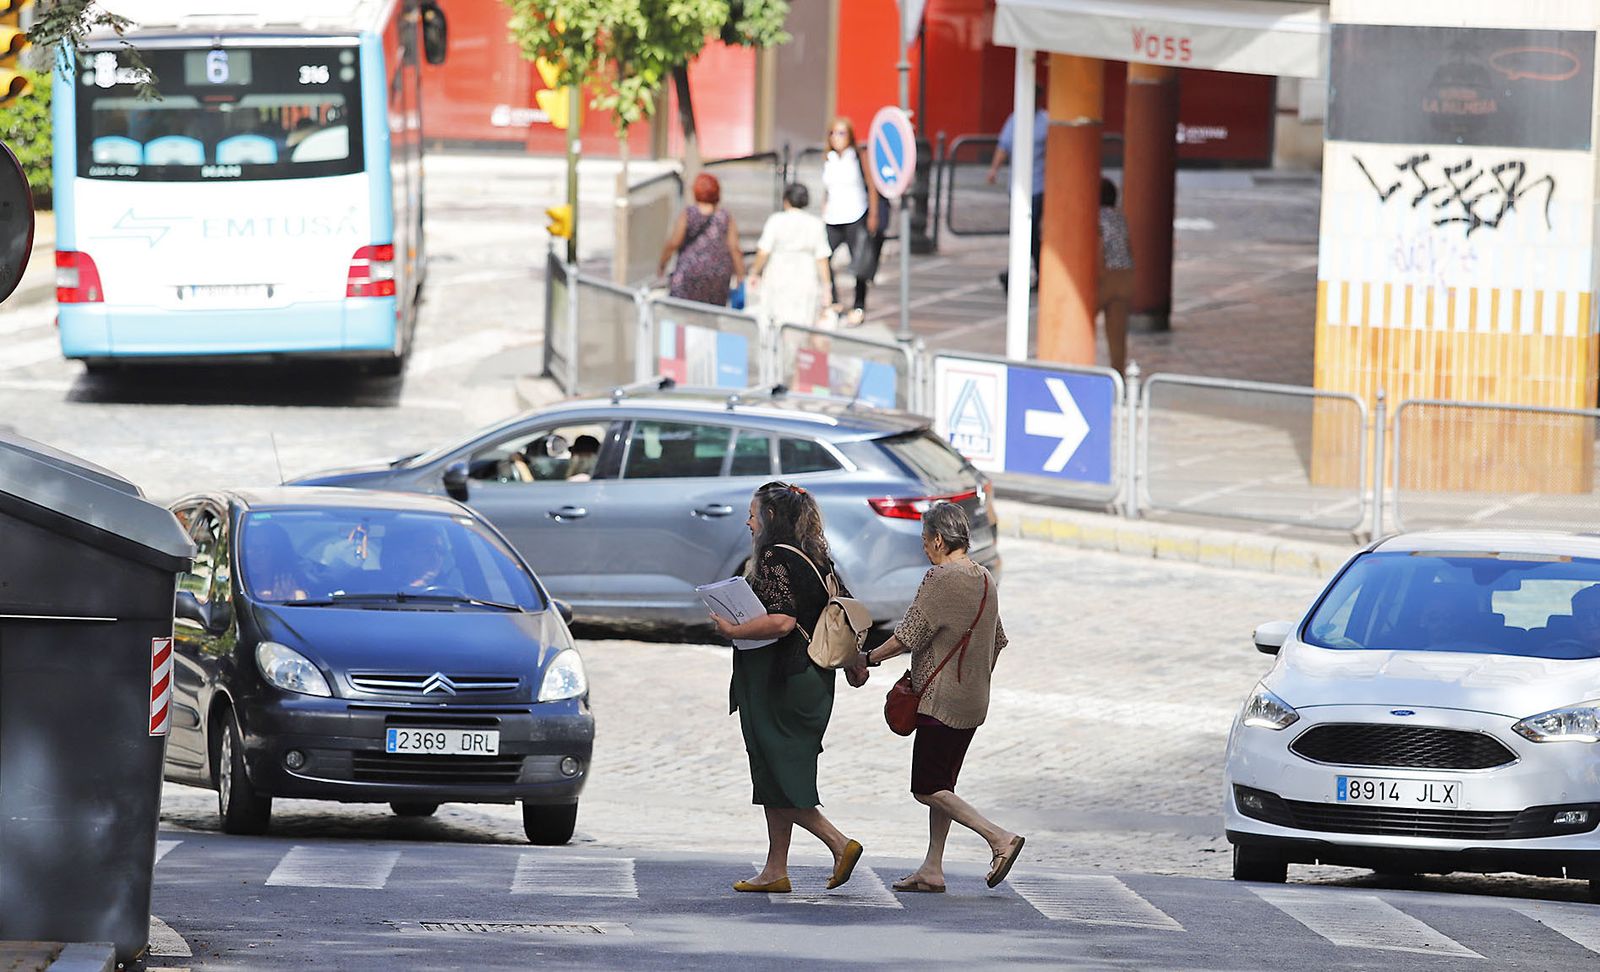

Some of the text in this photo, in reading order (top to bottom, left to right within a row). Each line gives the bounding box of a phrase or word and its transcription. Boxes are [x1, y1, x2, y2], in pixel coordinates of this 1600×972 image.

[1131, 26, 1193, 62] VOSS
[206, 50, 229, 84] 6
[398, 731, 495, 753] 2369 DRL
[1349, 780, 1454, 804] 8914 JLX
